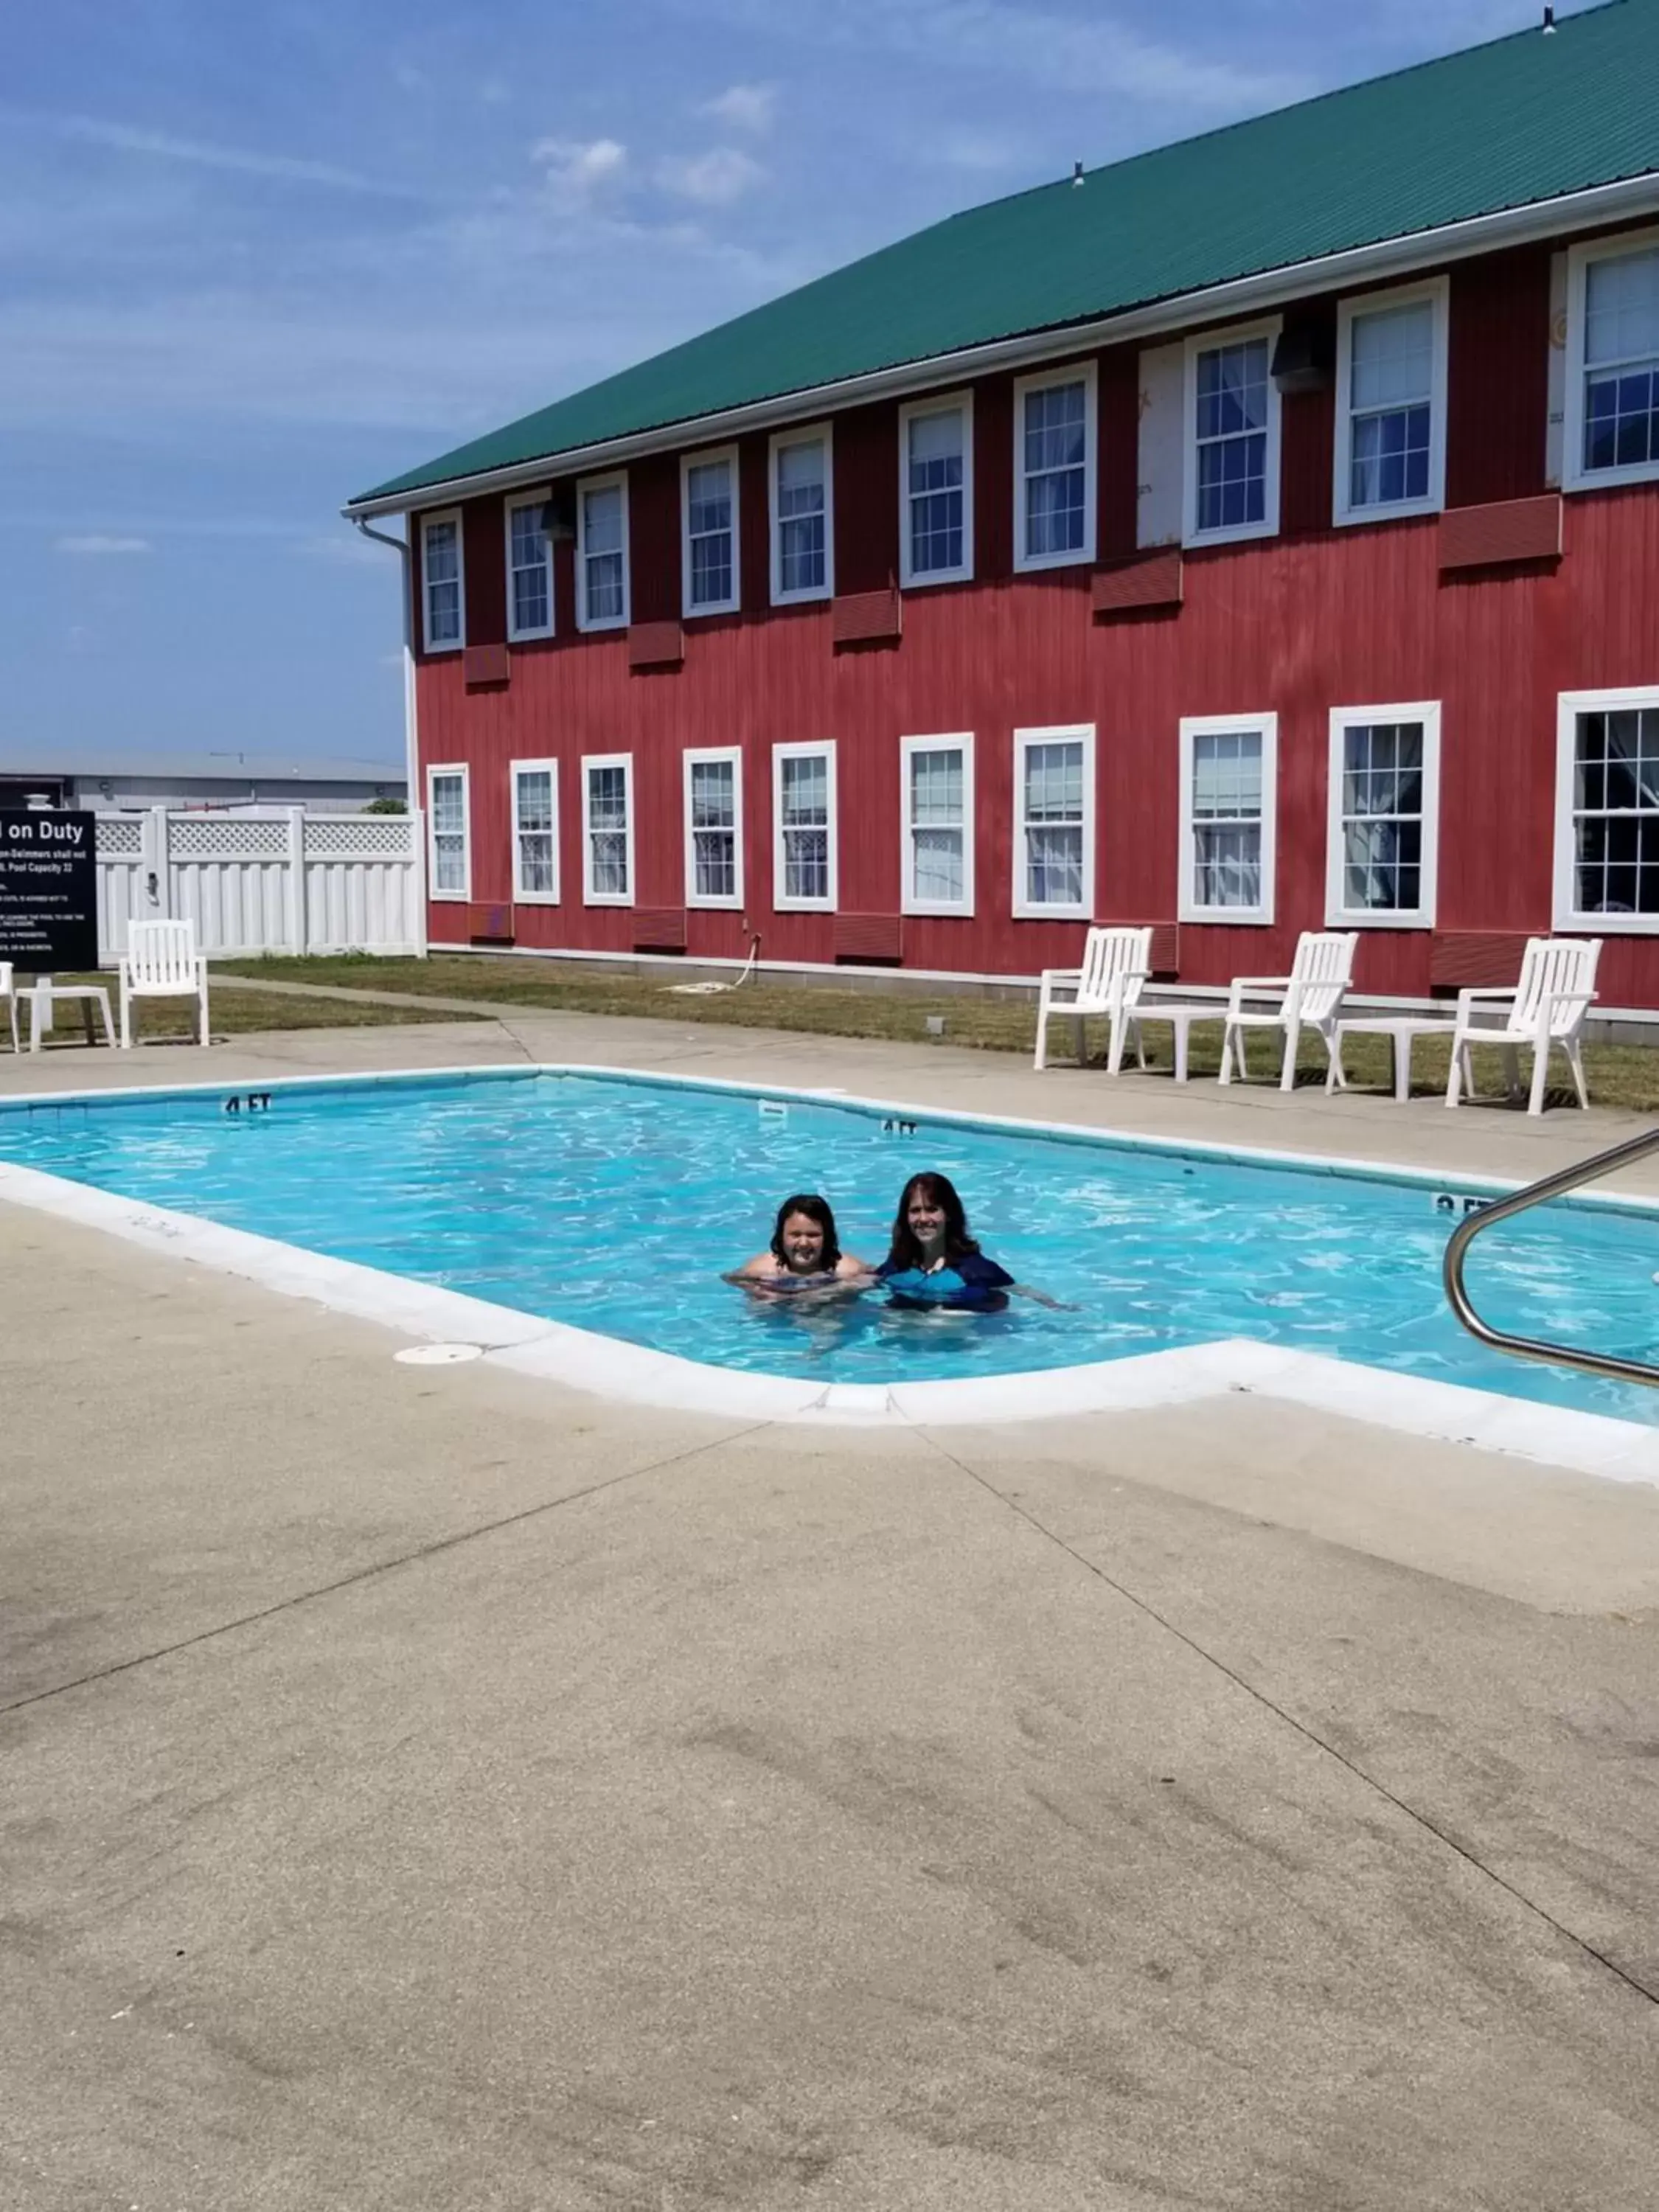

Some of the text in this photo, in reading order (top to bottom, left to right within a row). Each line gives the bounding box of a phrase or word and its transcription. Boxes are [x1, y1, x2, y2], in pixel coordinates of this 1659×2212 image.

[9, 824, 32, 839] on
[40, 821, 83, 844] Duty
[9, 862, 27, 872] Pool
[29, 862, 61, 874] Capacity
